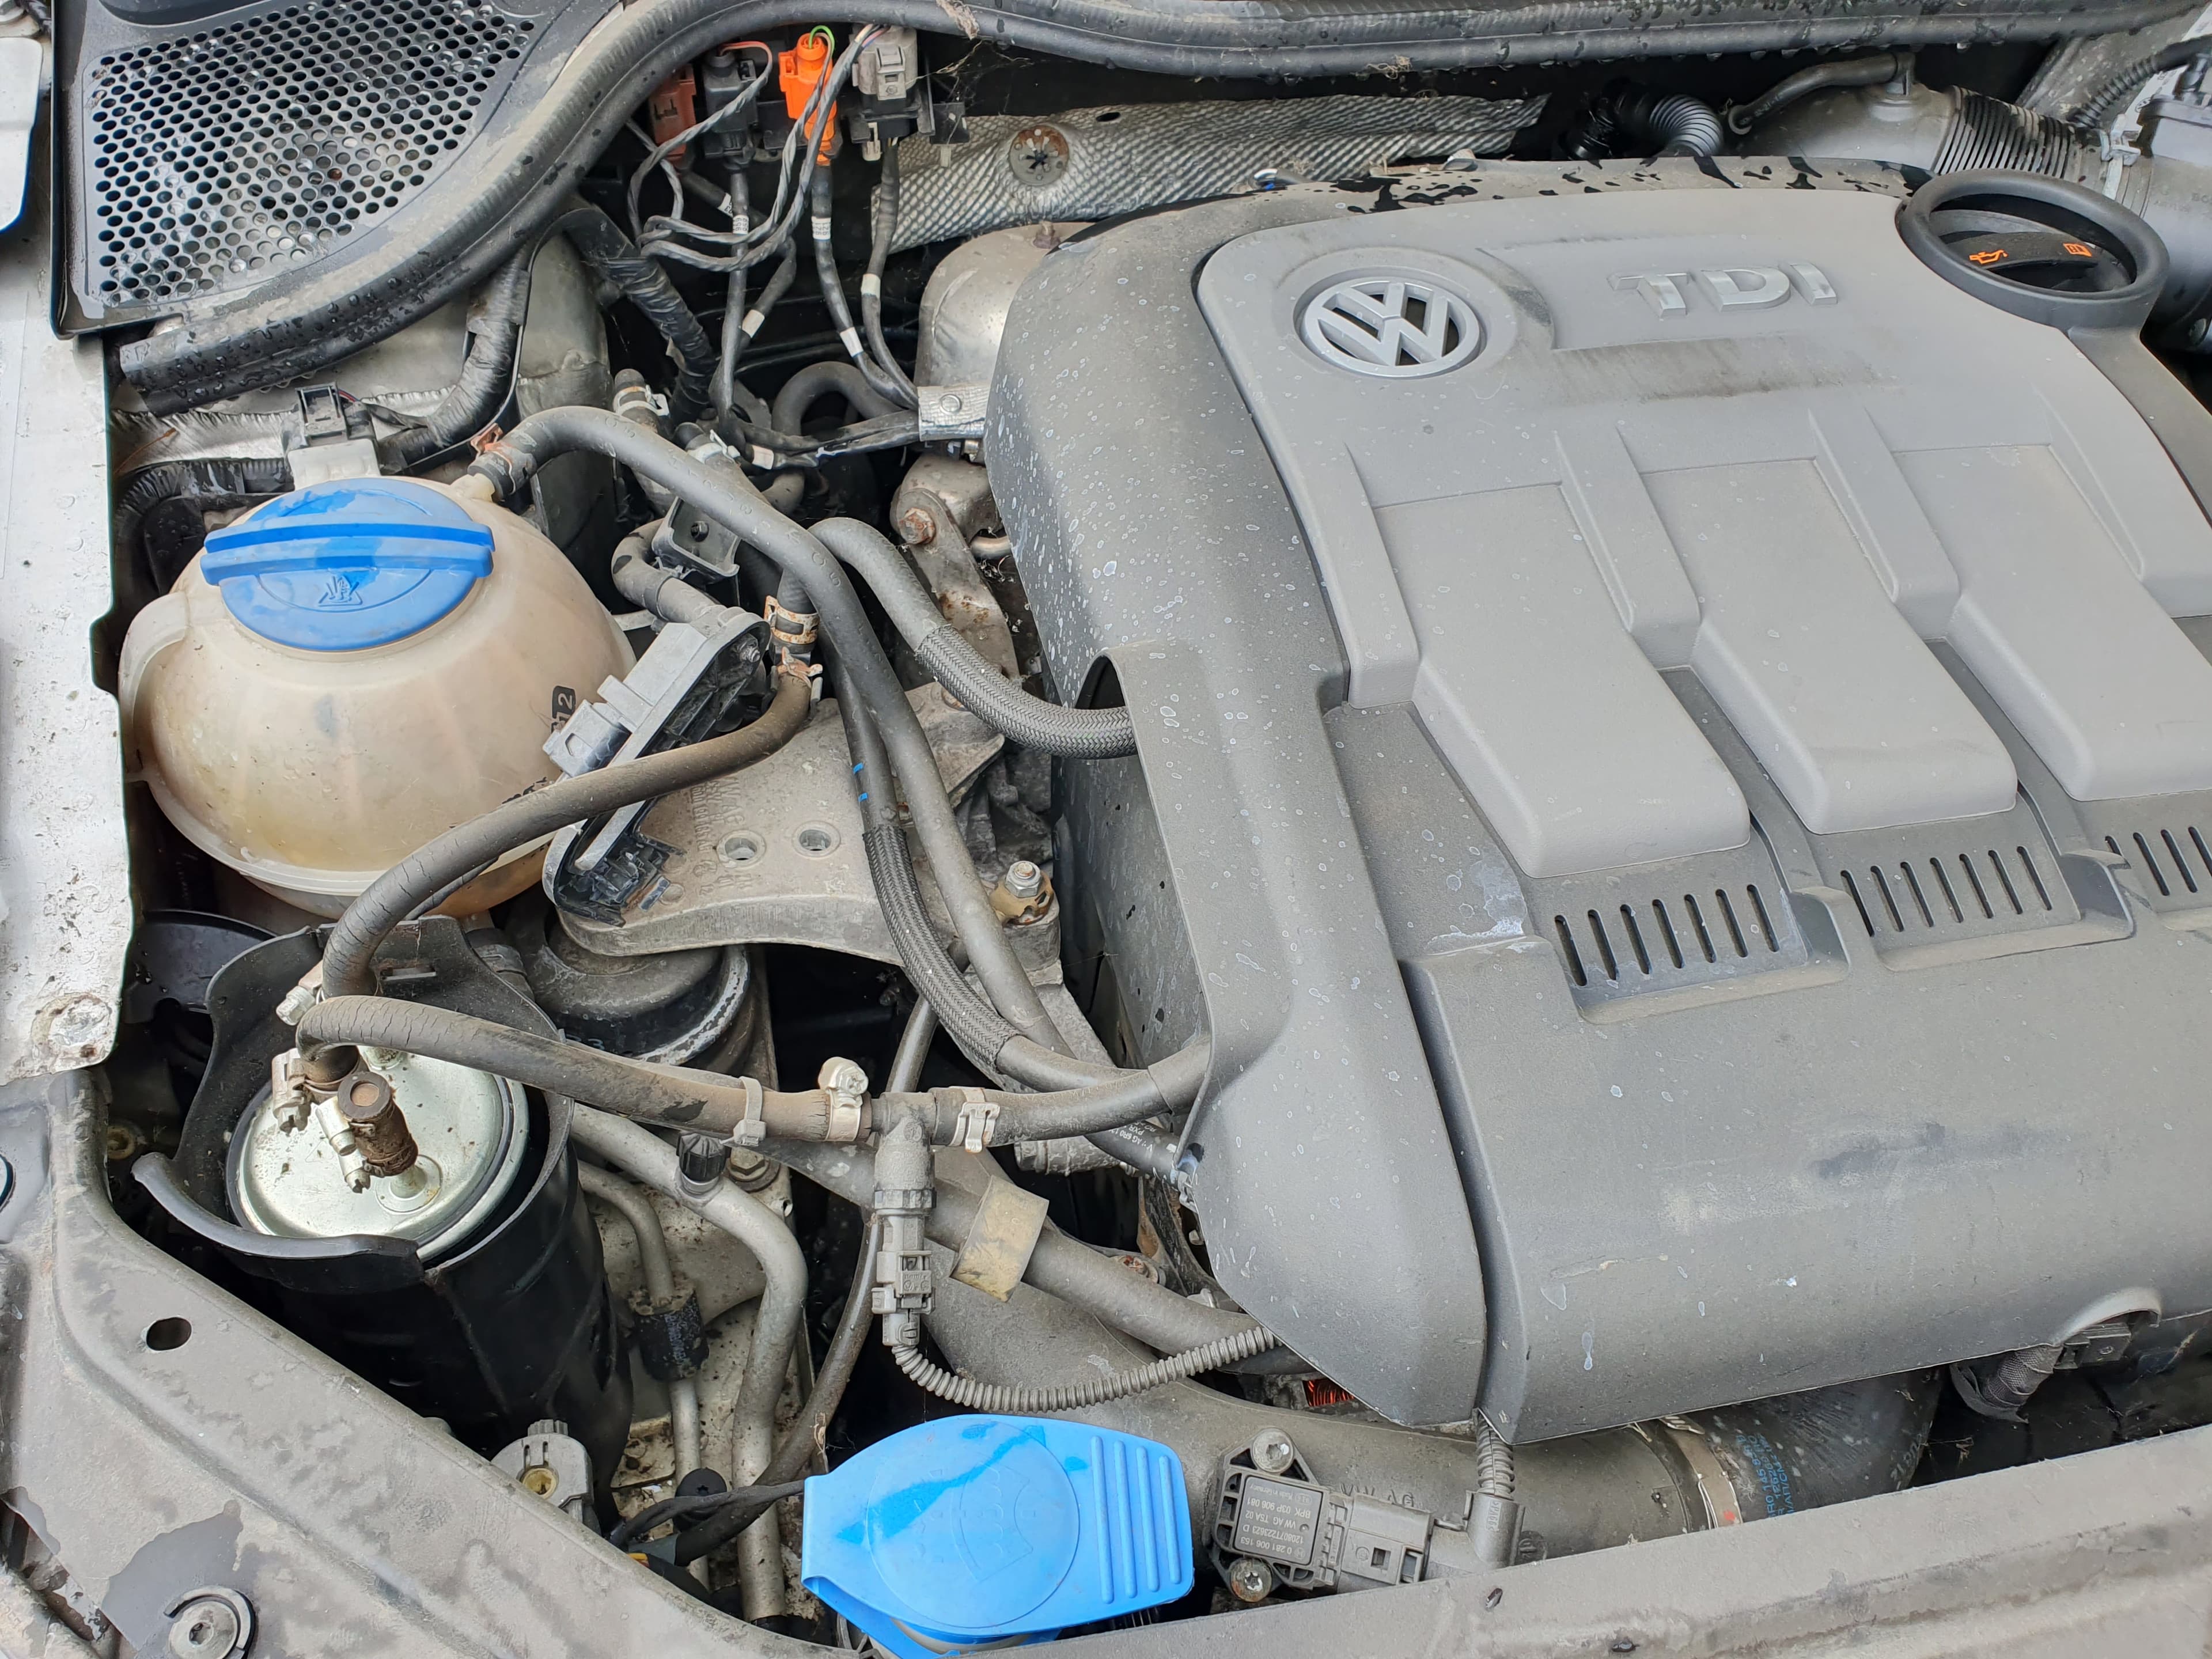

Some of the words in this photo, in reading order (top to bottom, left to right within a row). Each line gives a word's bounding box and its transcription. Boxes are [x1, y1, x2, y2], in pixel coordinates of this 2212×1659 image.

[1607, 262, 1839, 318] TDI
[1305, 276, 1480, 378] VW
[1132, 1136, 1142, 1145] AG
[1247, 1497, 1260, 1507] 081
[1262, 1500, 1275, 1510] 906
[1277, 1504, 1290, 1514] 03P
[1294, 1508, 1311, 1519] BPK
[1245, 1510, 1254, 1519] 02
[1256, 1512, 1268, 1523] TSA
[1273, 1517, 1283, 1526] AG
[1284, 1520, 1296, 1529] VW
[1256, 1540, 1270, 1549] 006
[1272, 1544, 1286, 1553] 281
